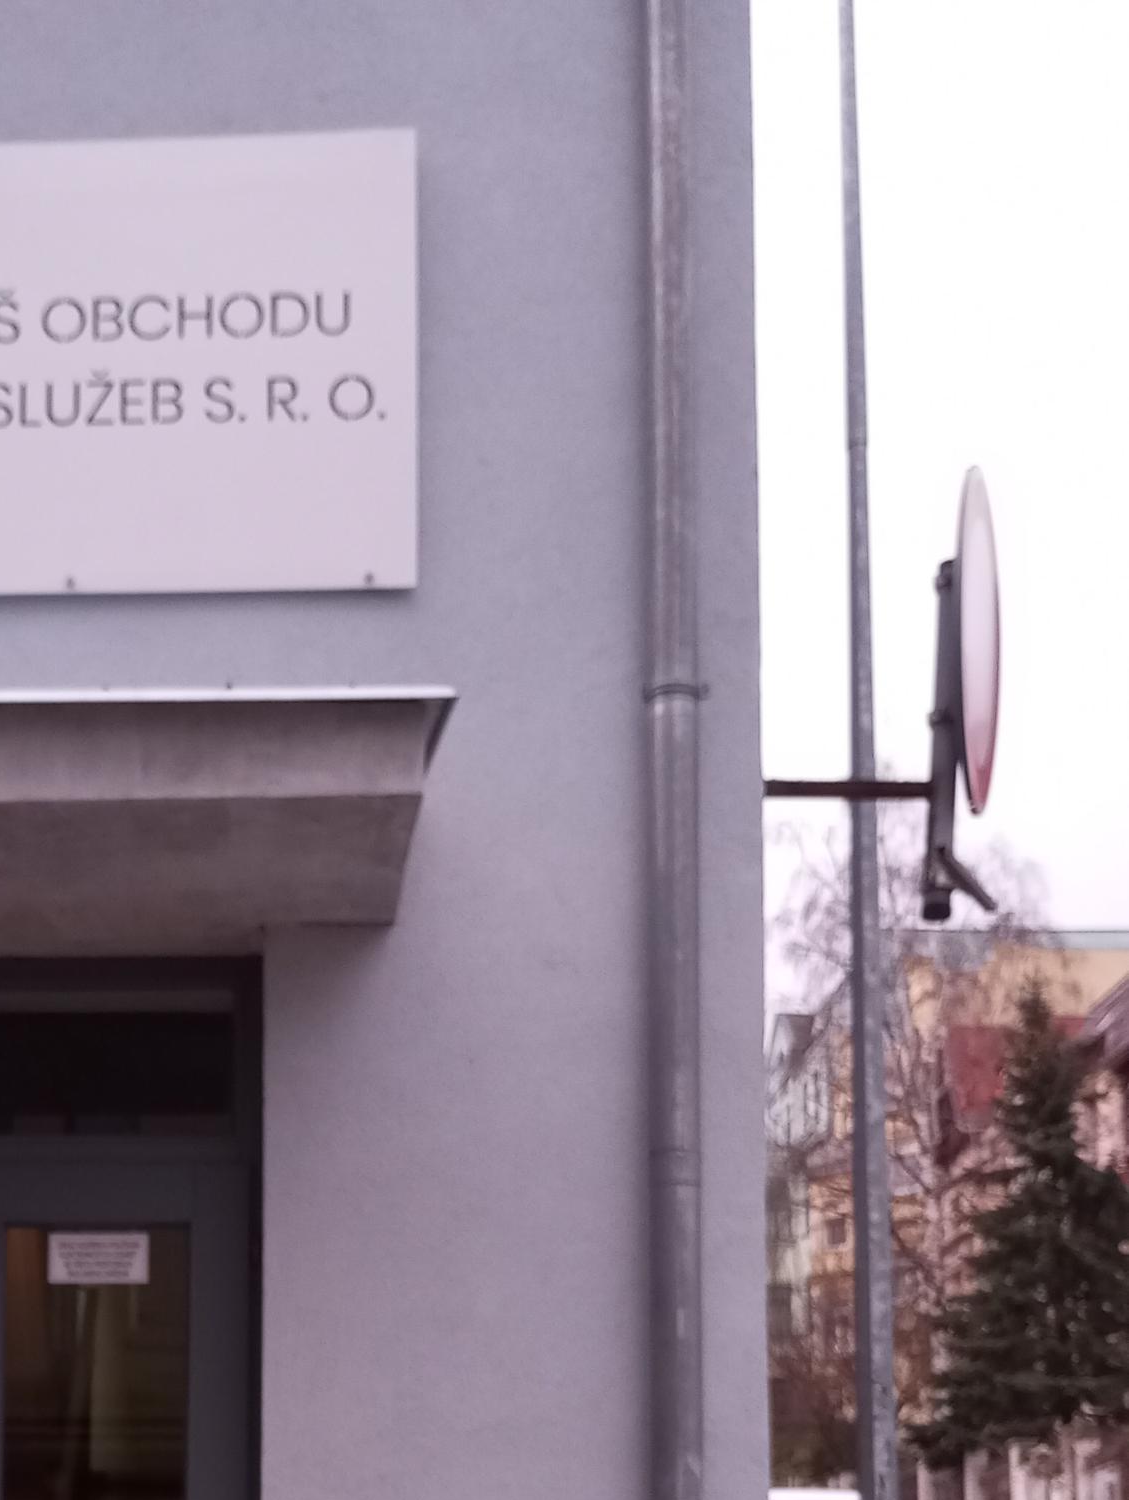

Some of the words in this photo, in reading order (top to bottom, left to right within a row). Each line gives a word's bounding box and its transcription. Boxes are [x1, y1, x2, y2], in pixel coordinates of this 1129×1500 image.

[41, 292, 352, 343] OBCHODU
[203, 376, 248, 425] S.
[266, 375, 310, 423] R.
[328, 374, 387, 423] O.
